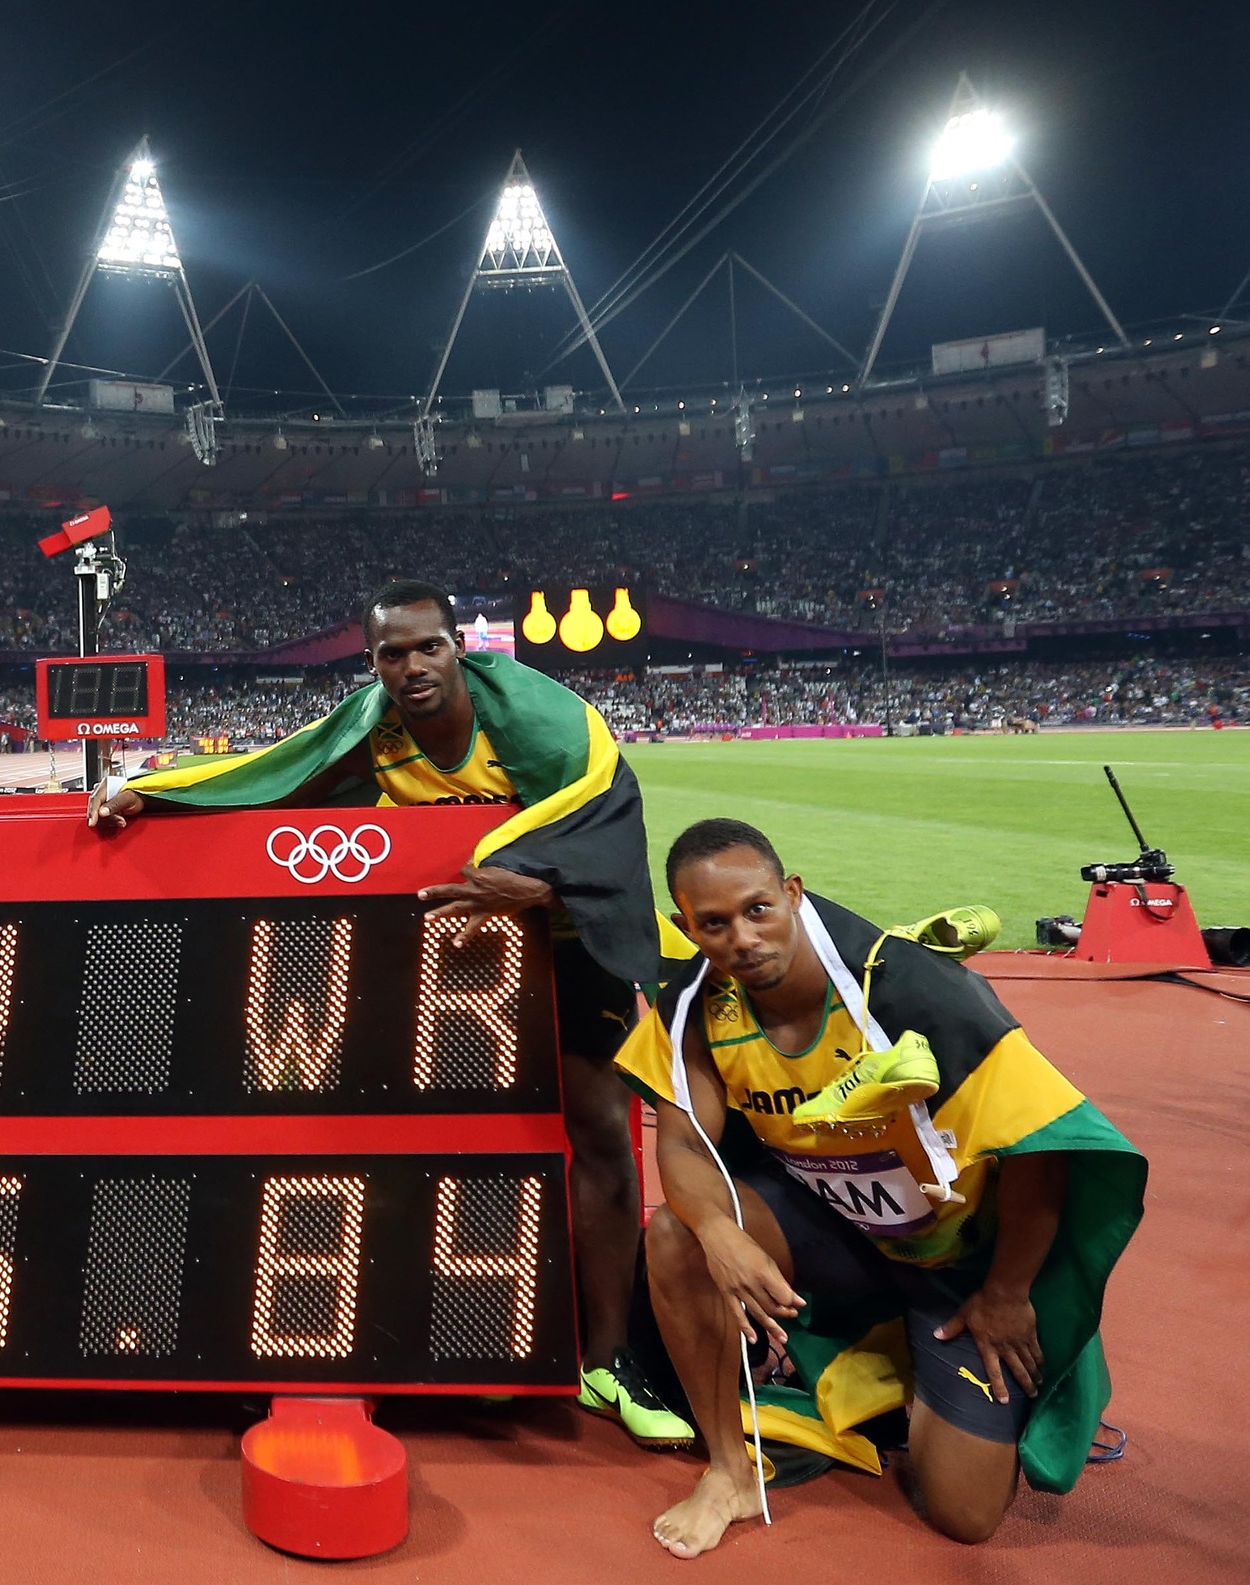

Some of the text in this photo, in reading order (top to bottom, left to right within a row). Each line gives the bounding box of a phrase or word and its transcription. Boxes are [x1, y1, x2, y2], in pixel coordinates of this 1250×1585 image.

[93, 722, 140, 735] OMEGA
[246, 914, 524, 1092] WR
[829, 1160, 859, 1171] 2012
